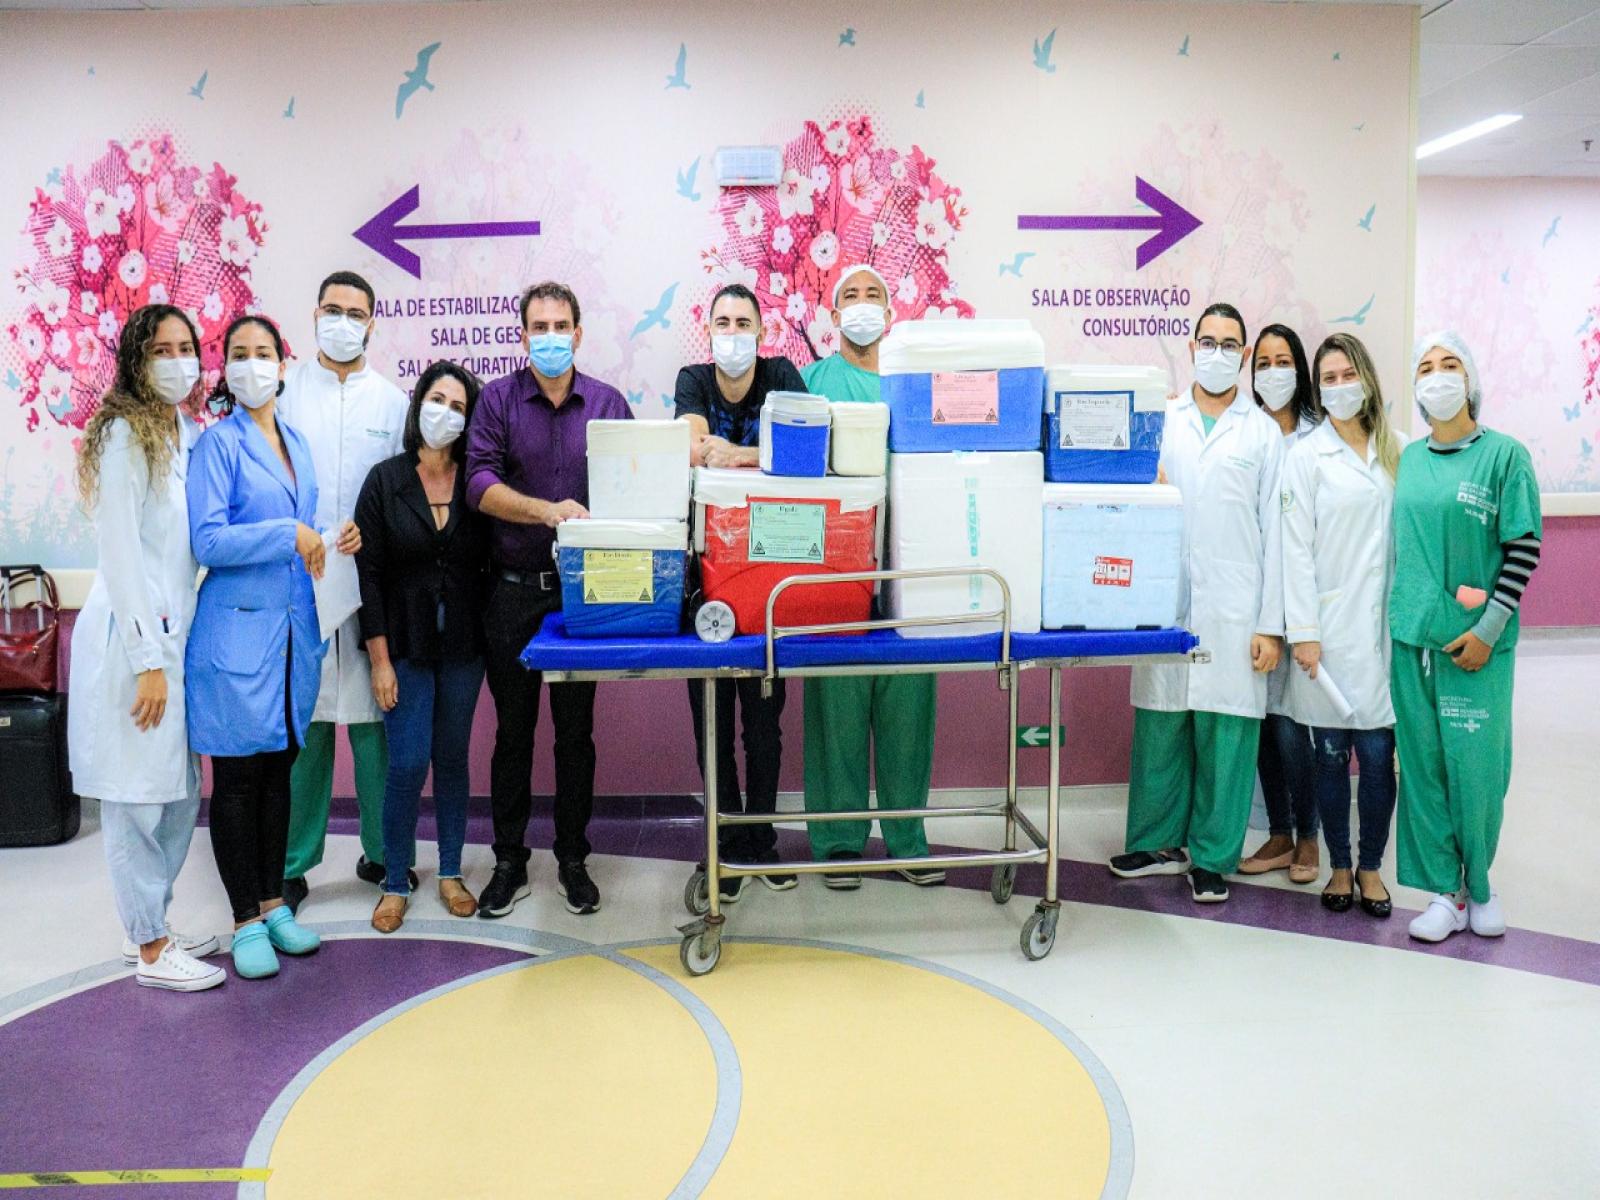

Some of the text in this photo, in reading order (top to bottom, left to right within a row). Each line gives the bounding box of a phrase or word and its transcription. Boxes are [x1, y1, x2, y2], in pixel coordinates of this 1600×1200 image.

[375, 295, 520, 319] ALA DE ESTABILIZAÇ
[1032, 285, 1191, 311] SALA DE OBSERVAÇÃO
[431, 326, 522, 346] SALA DE GES
[1082, 315, 1191, 336] CONSULTÓRIOS
[461, 355, 529, 375] CURATIV
